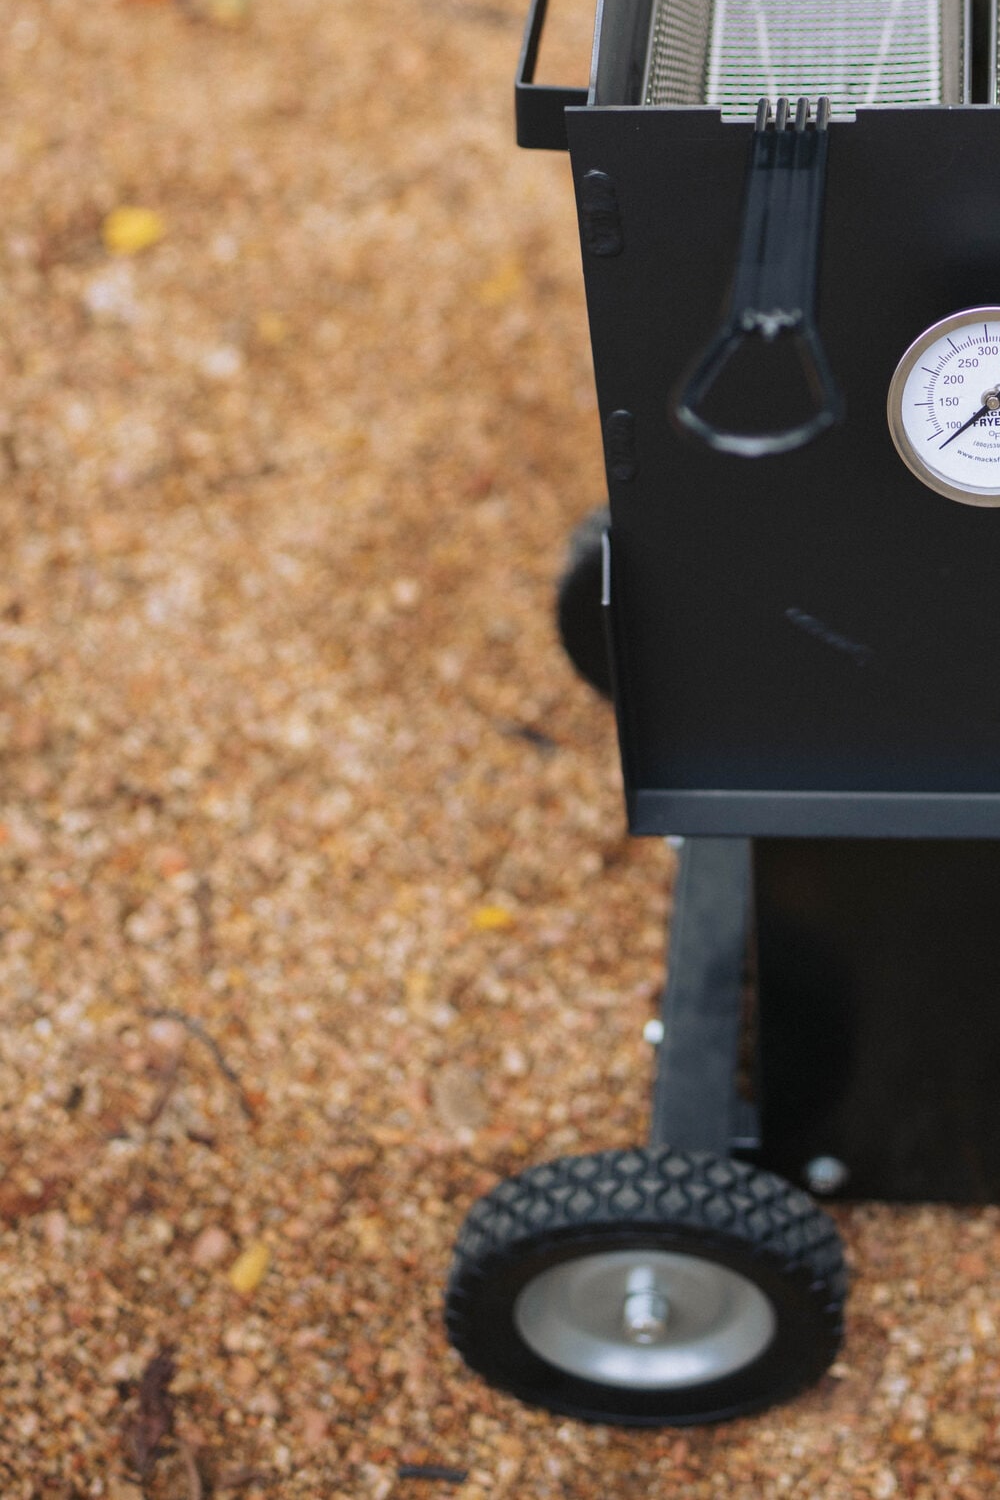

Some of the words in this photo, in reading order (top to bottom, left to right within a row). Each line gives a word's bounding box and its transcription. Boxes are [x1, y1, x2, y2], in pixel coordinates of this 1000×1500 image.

[977, 346, 999, 356] 300
[958, 358, 979, 368] 250
[943, 374, 964, 385] 200
[939, 397, 959, 407] 150
[946, 421, 962, 429] 100
